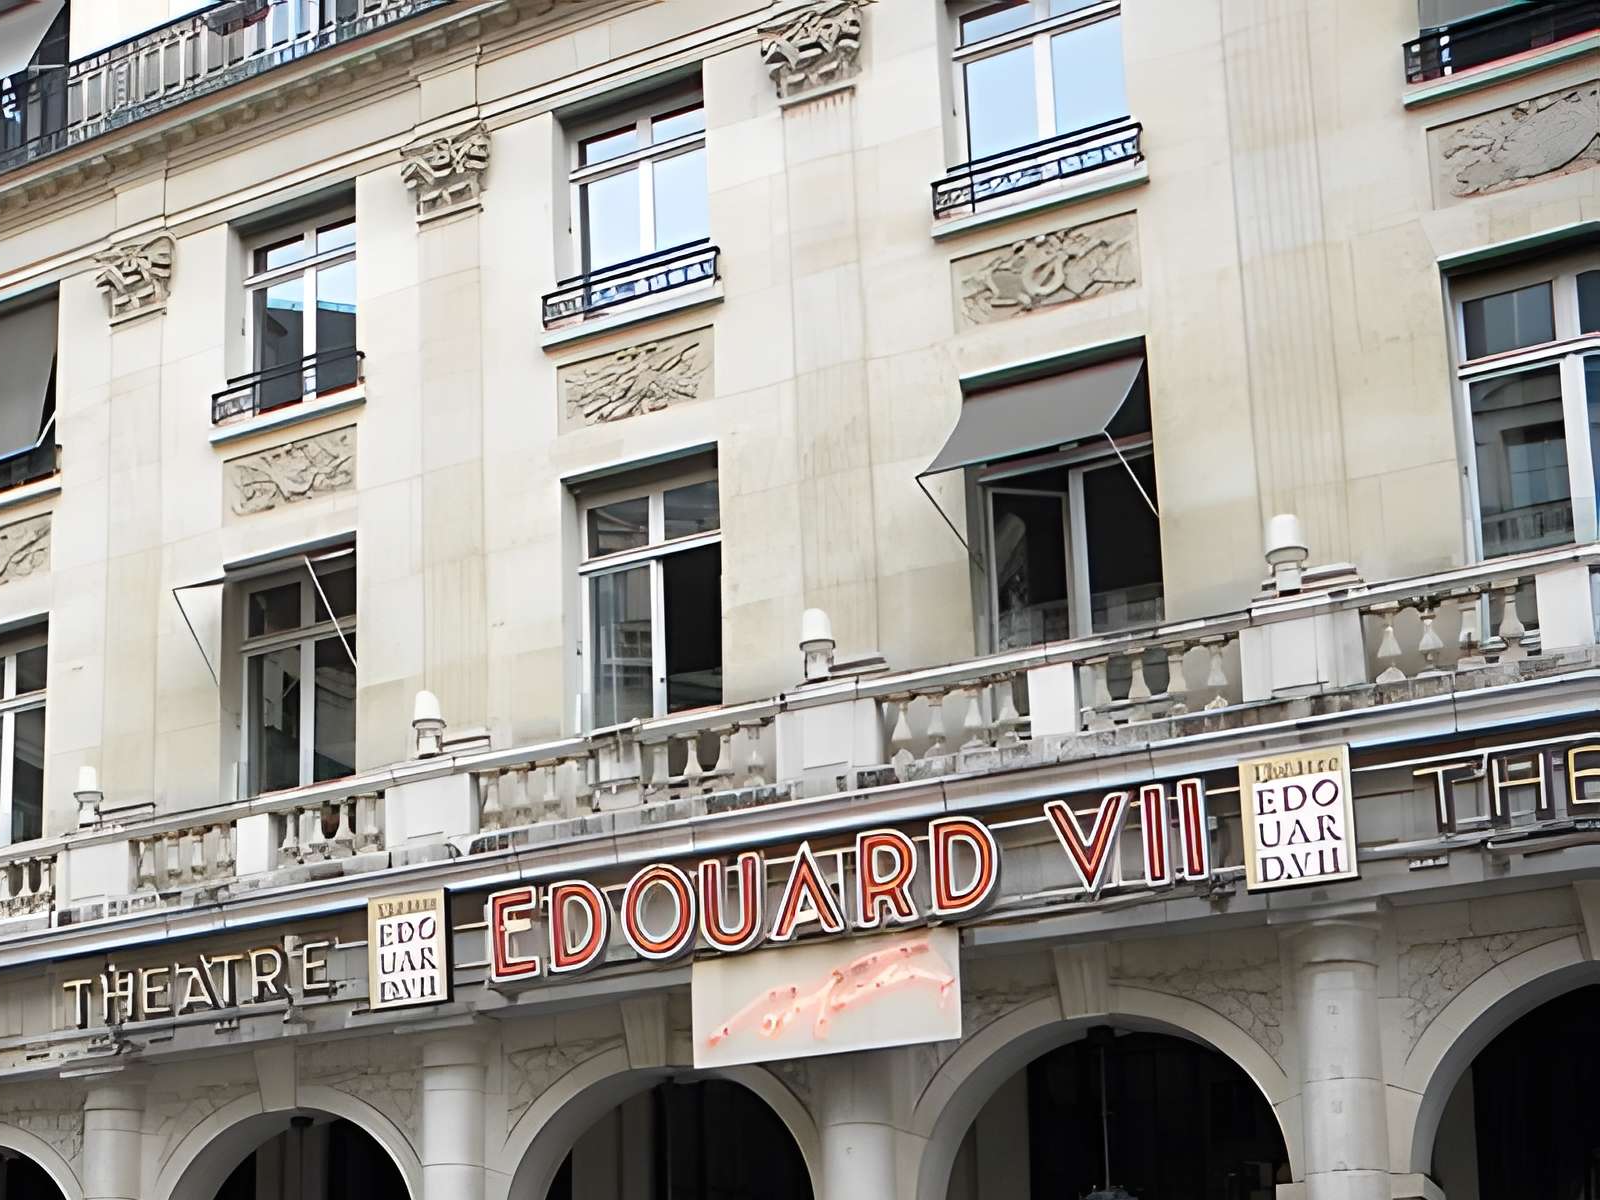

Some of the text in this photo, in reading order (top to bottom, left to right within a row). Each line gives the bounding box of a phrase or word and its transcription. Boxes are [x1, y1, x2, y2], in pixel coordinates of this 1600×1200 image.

[1256, 778, 1340, 816] EDO
[1258, 814, 1342, 848] UAR
[488, 778, 1208, 983] EDOUARD VII
[380, 916, 437, 948] EDO
[380, 946, 438, 976] UAR
[62, 938, 334, 1029] THEATRE
